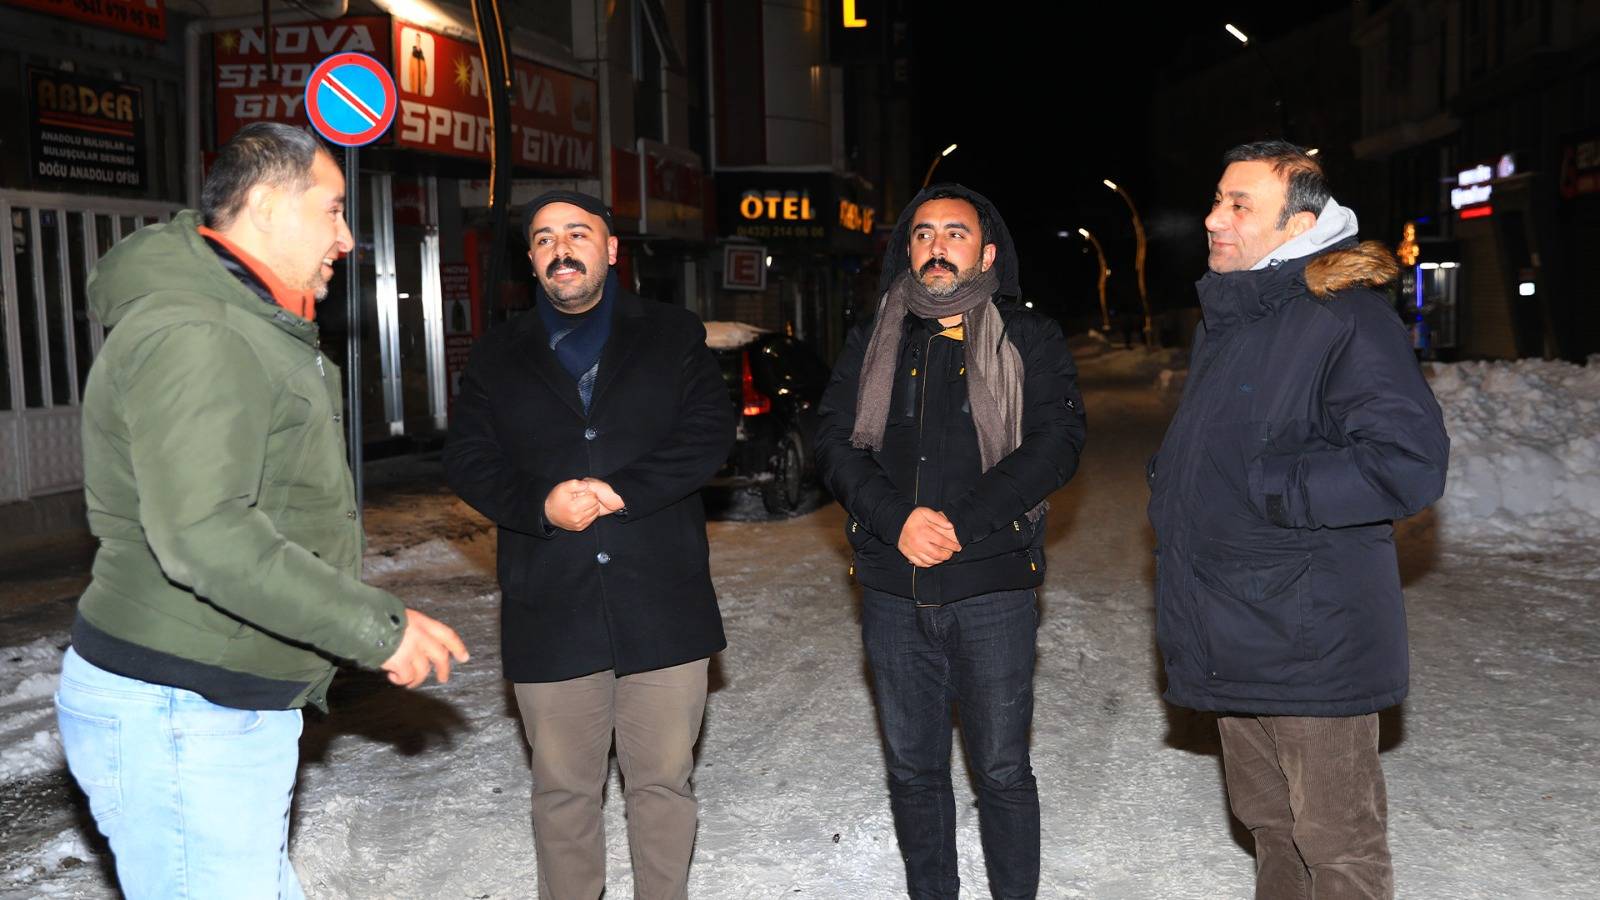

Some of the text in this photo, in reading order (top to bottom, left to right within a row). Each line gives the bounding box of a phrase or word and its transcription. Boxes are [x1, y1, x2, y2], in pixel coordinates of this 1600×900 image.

[239, 24, 375, 55] NOVA
[36, 78, 134, 121] ABDER
[470, 56, 557, 116] NVA
[41, 131, 81, 145] ANADOLU
[400, 99, 518, 153] SPOR
[39, 160, 67, 177] DOĞU
[70, 165, 114, 181] ANADOLU
[740, 195, 815, 220] OTEL
